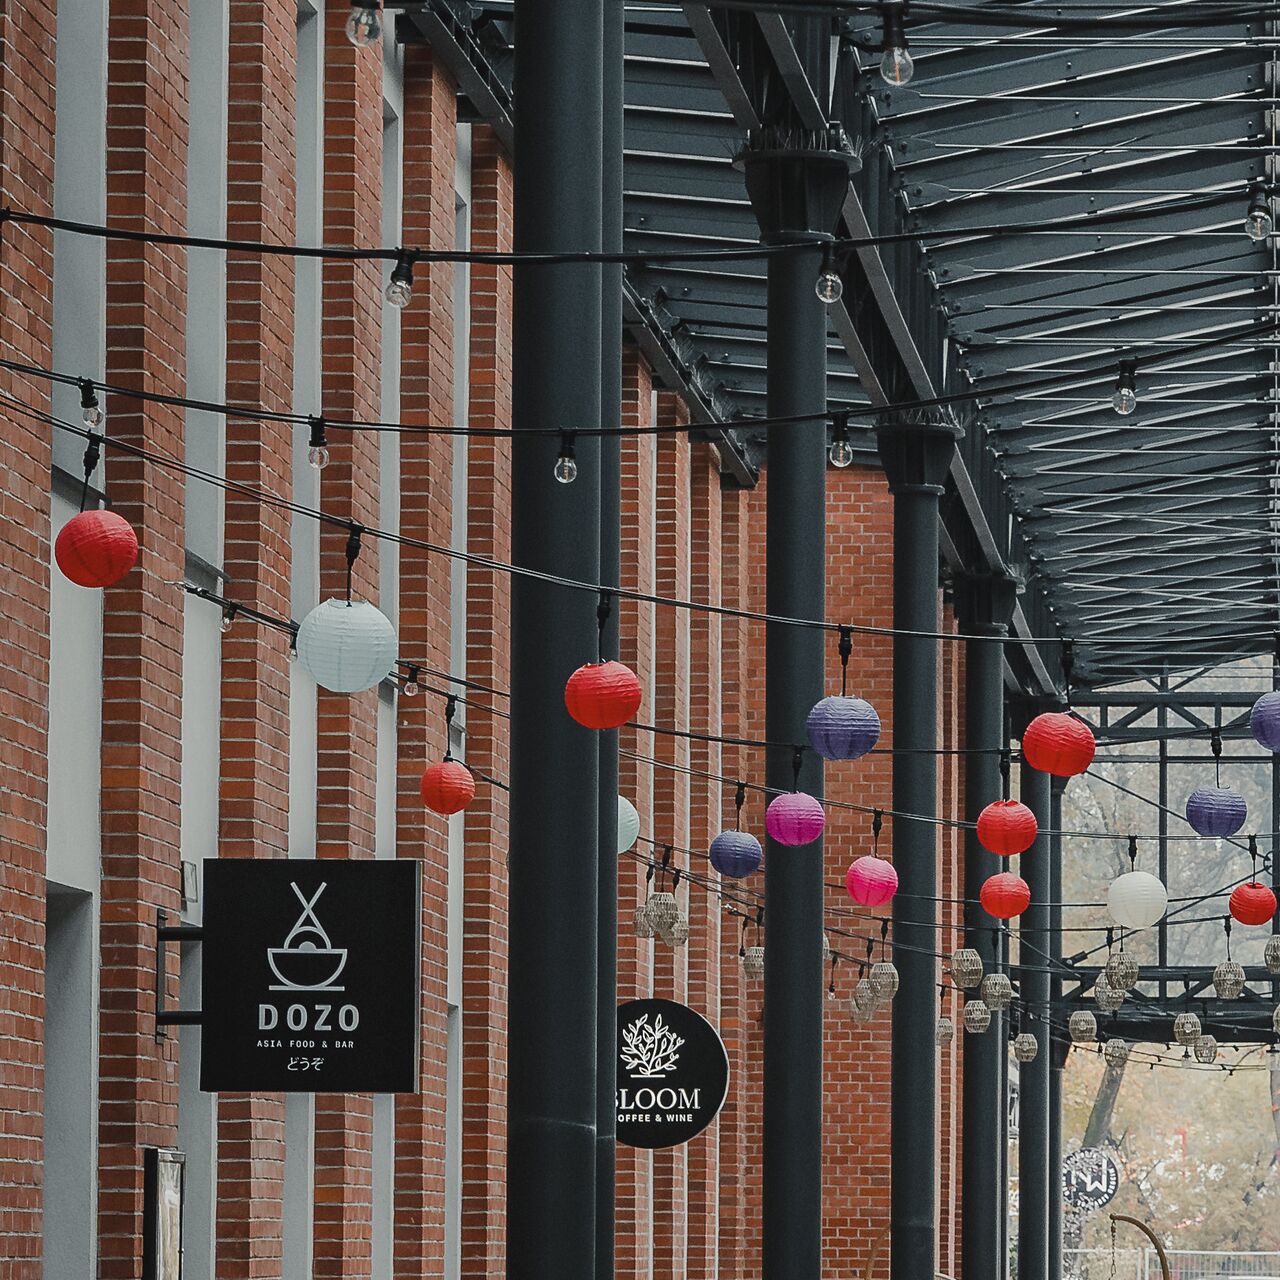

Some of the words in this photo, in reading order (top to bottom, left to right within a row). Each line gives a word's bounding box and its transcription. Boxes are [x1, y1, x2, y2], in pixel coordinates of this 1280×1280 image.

[258, 1004, 360, 1031] DOZO
[256, 1039, 283, 1048] ASIA
[289, 1039, 315, 1049] FOOD
[321, 1040, 328, 1049] &
[335, 1040, 354, 1049] BAR
[287, 1056, 325, 1071] どうぞ
[615, 1087, 701, 1110] LOOM
[617, 1113, 651, 1123] OFFEE
[655, 1114, 662, 1122] &
[666, 1113, 693, 1122] WINE
